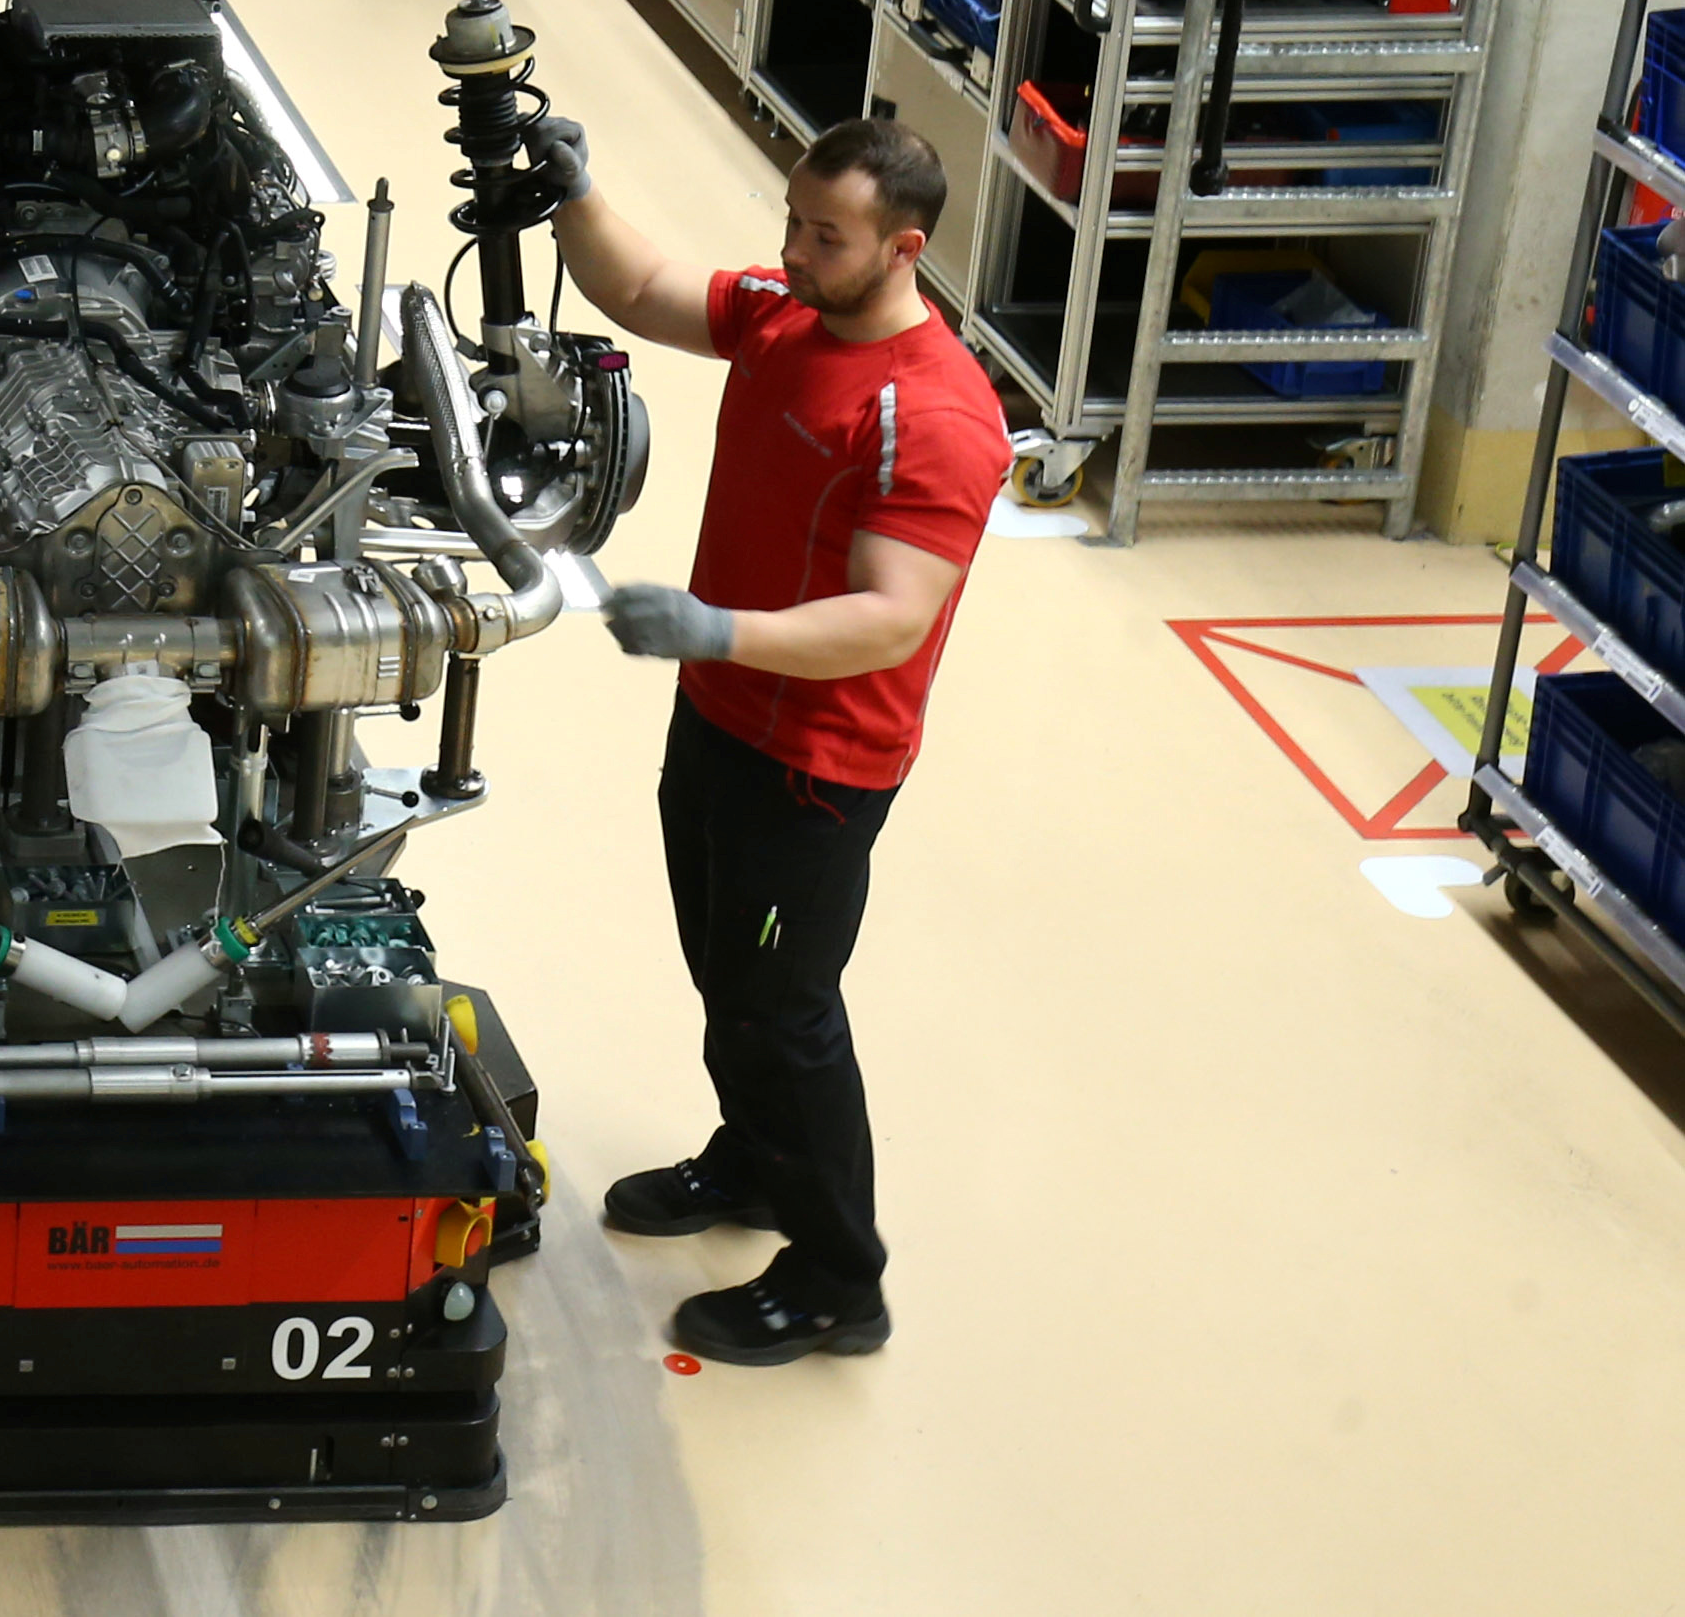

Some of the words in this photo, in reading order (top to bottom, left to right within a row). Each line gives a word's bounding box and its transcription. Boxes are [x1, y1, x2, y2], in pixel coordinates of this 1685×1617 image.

[48, 1220, 110, 1255] BÄR
[47, 1259, 220, 1271] www.baer-automation.de
[271, 1316, 375, 1381] 02
